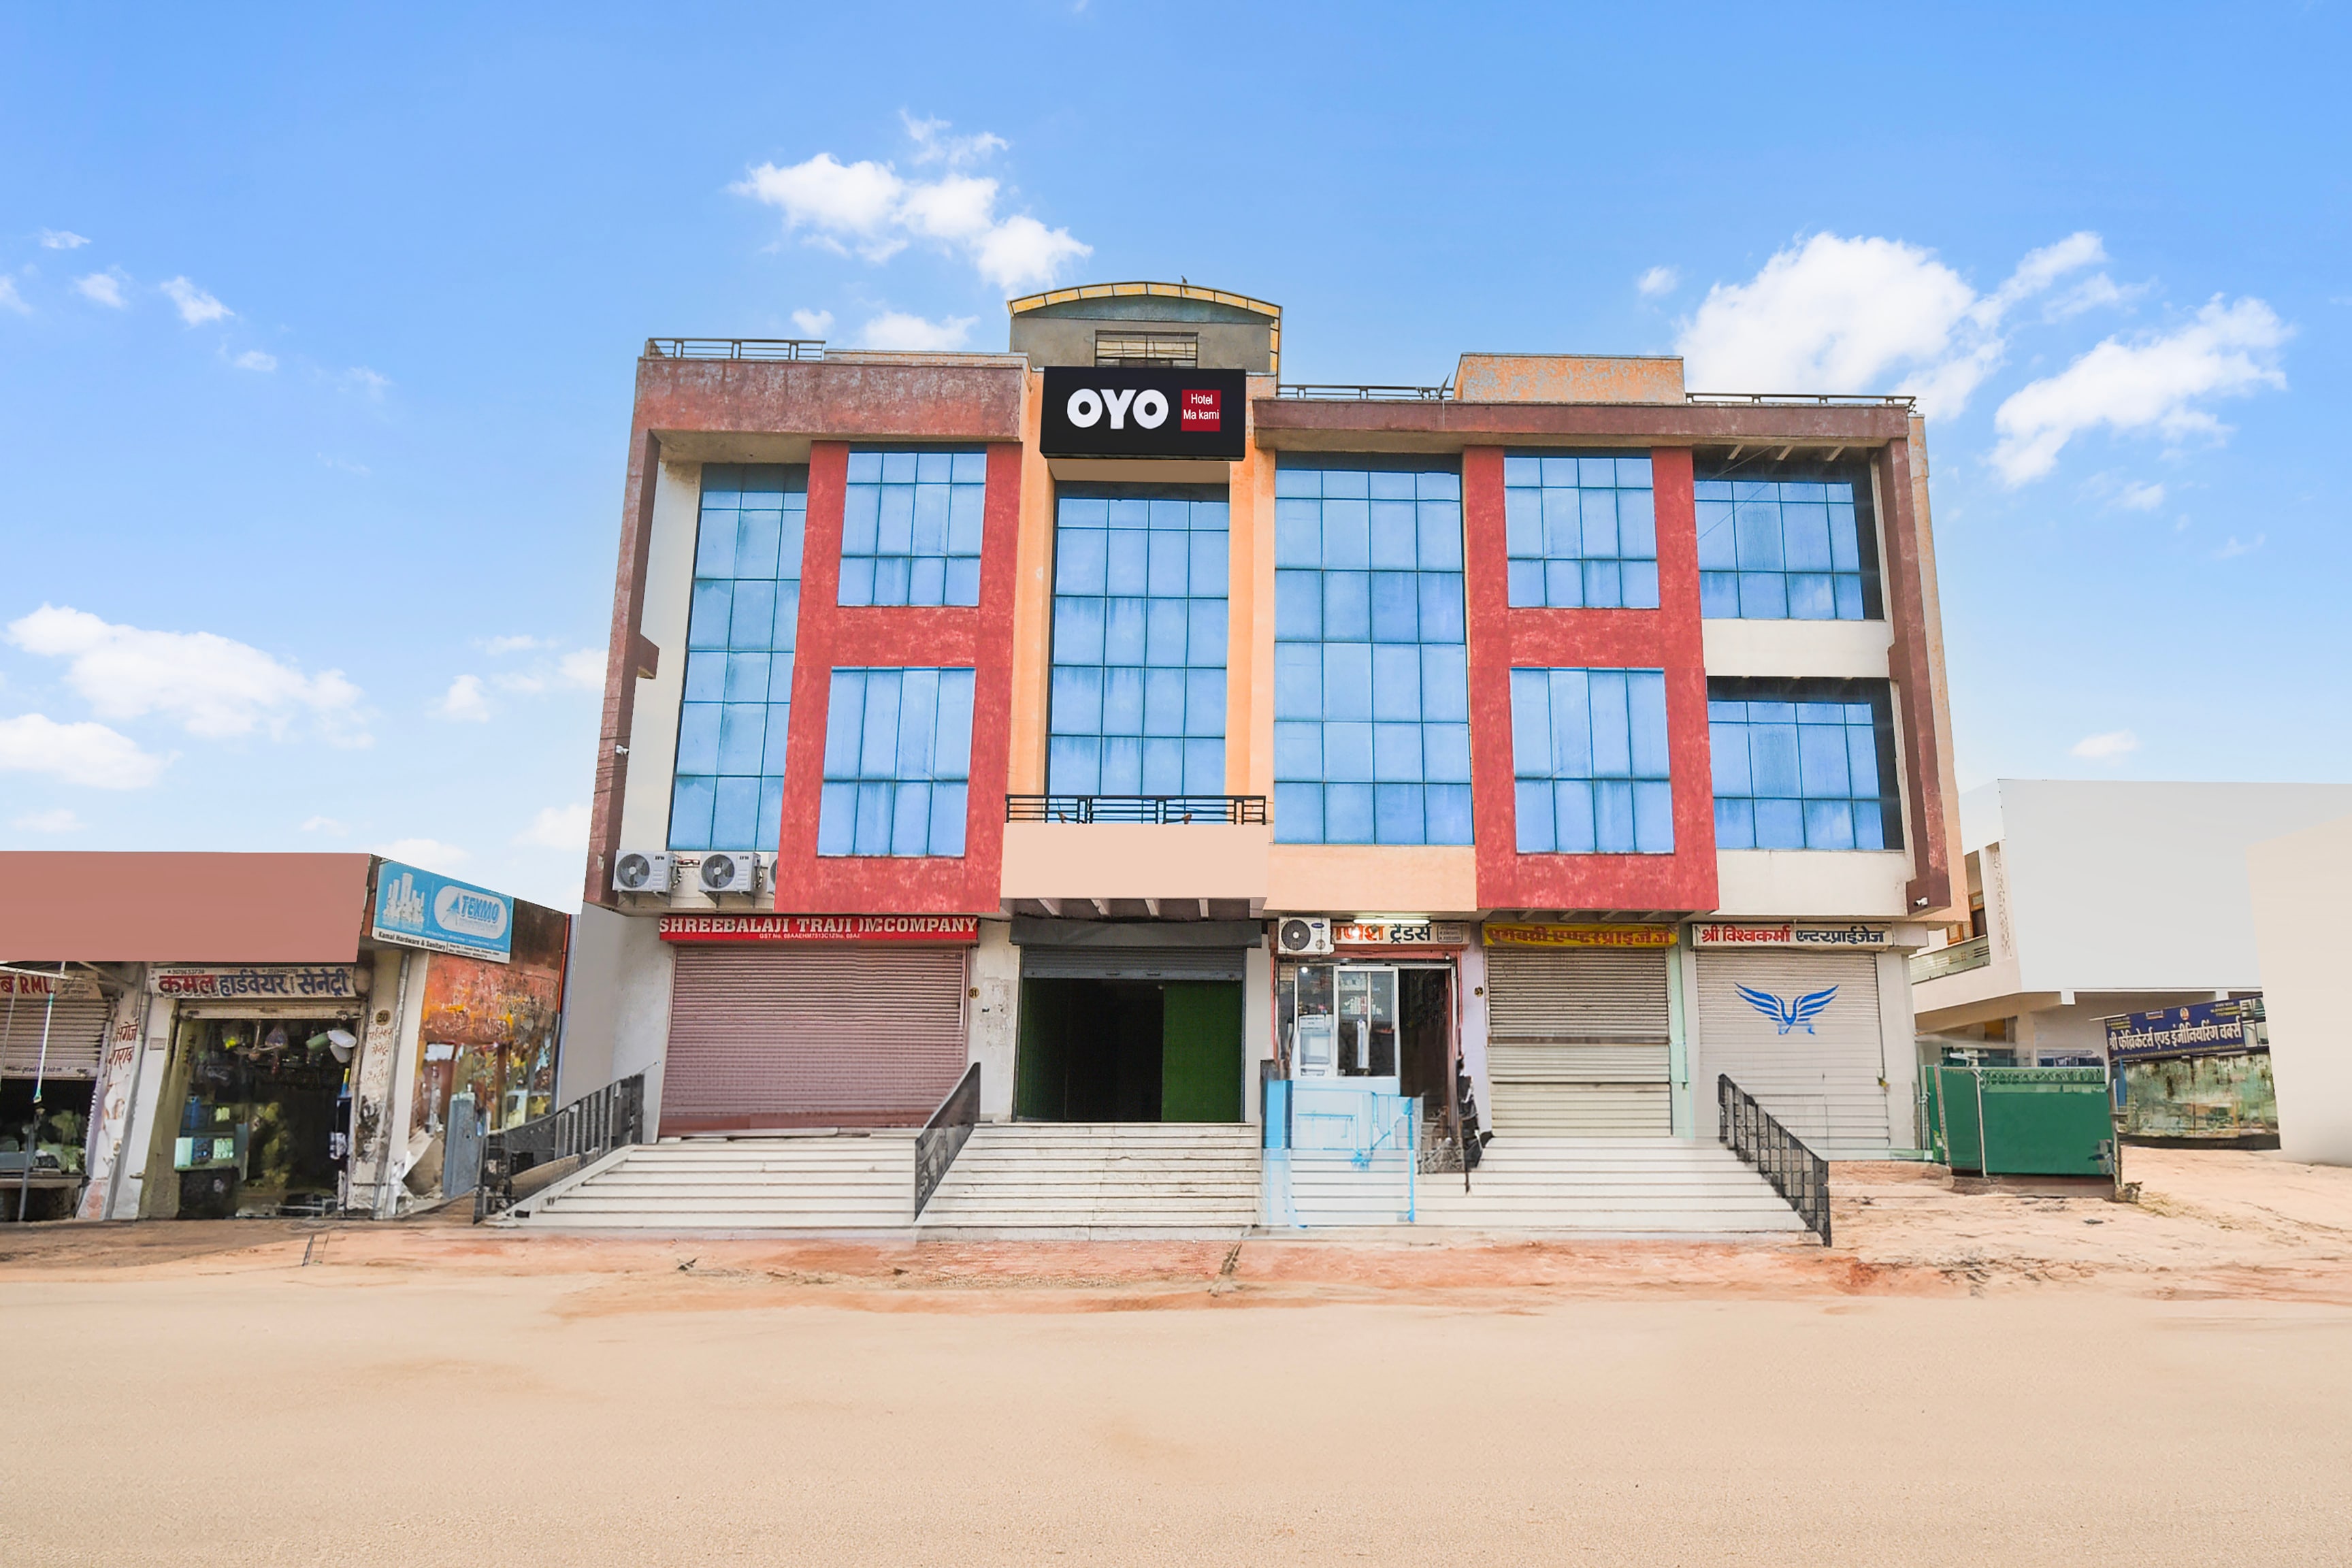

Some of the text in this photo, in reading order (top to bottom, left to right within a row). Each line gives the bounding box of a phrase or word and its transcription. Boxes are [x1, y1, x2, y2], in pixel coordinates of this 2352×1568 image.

[1191, 393, 1213, 405] Hotel
[1067, 389, 1169, 429] OYO
[1183, 409, 1220, 420] Ma kami
[461, 896, 500, 924] TEXMO
[378, 931, 395, 940] Kamal
[396, 934, 420, 945] Hardware
[1701, 924, 1719, 942] श्री
[1722, 924, 1791, 942] विश्वकर्मा
[159, 975, 217, 994] कमल
